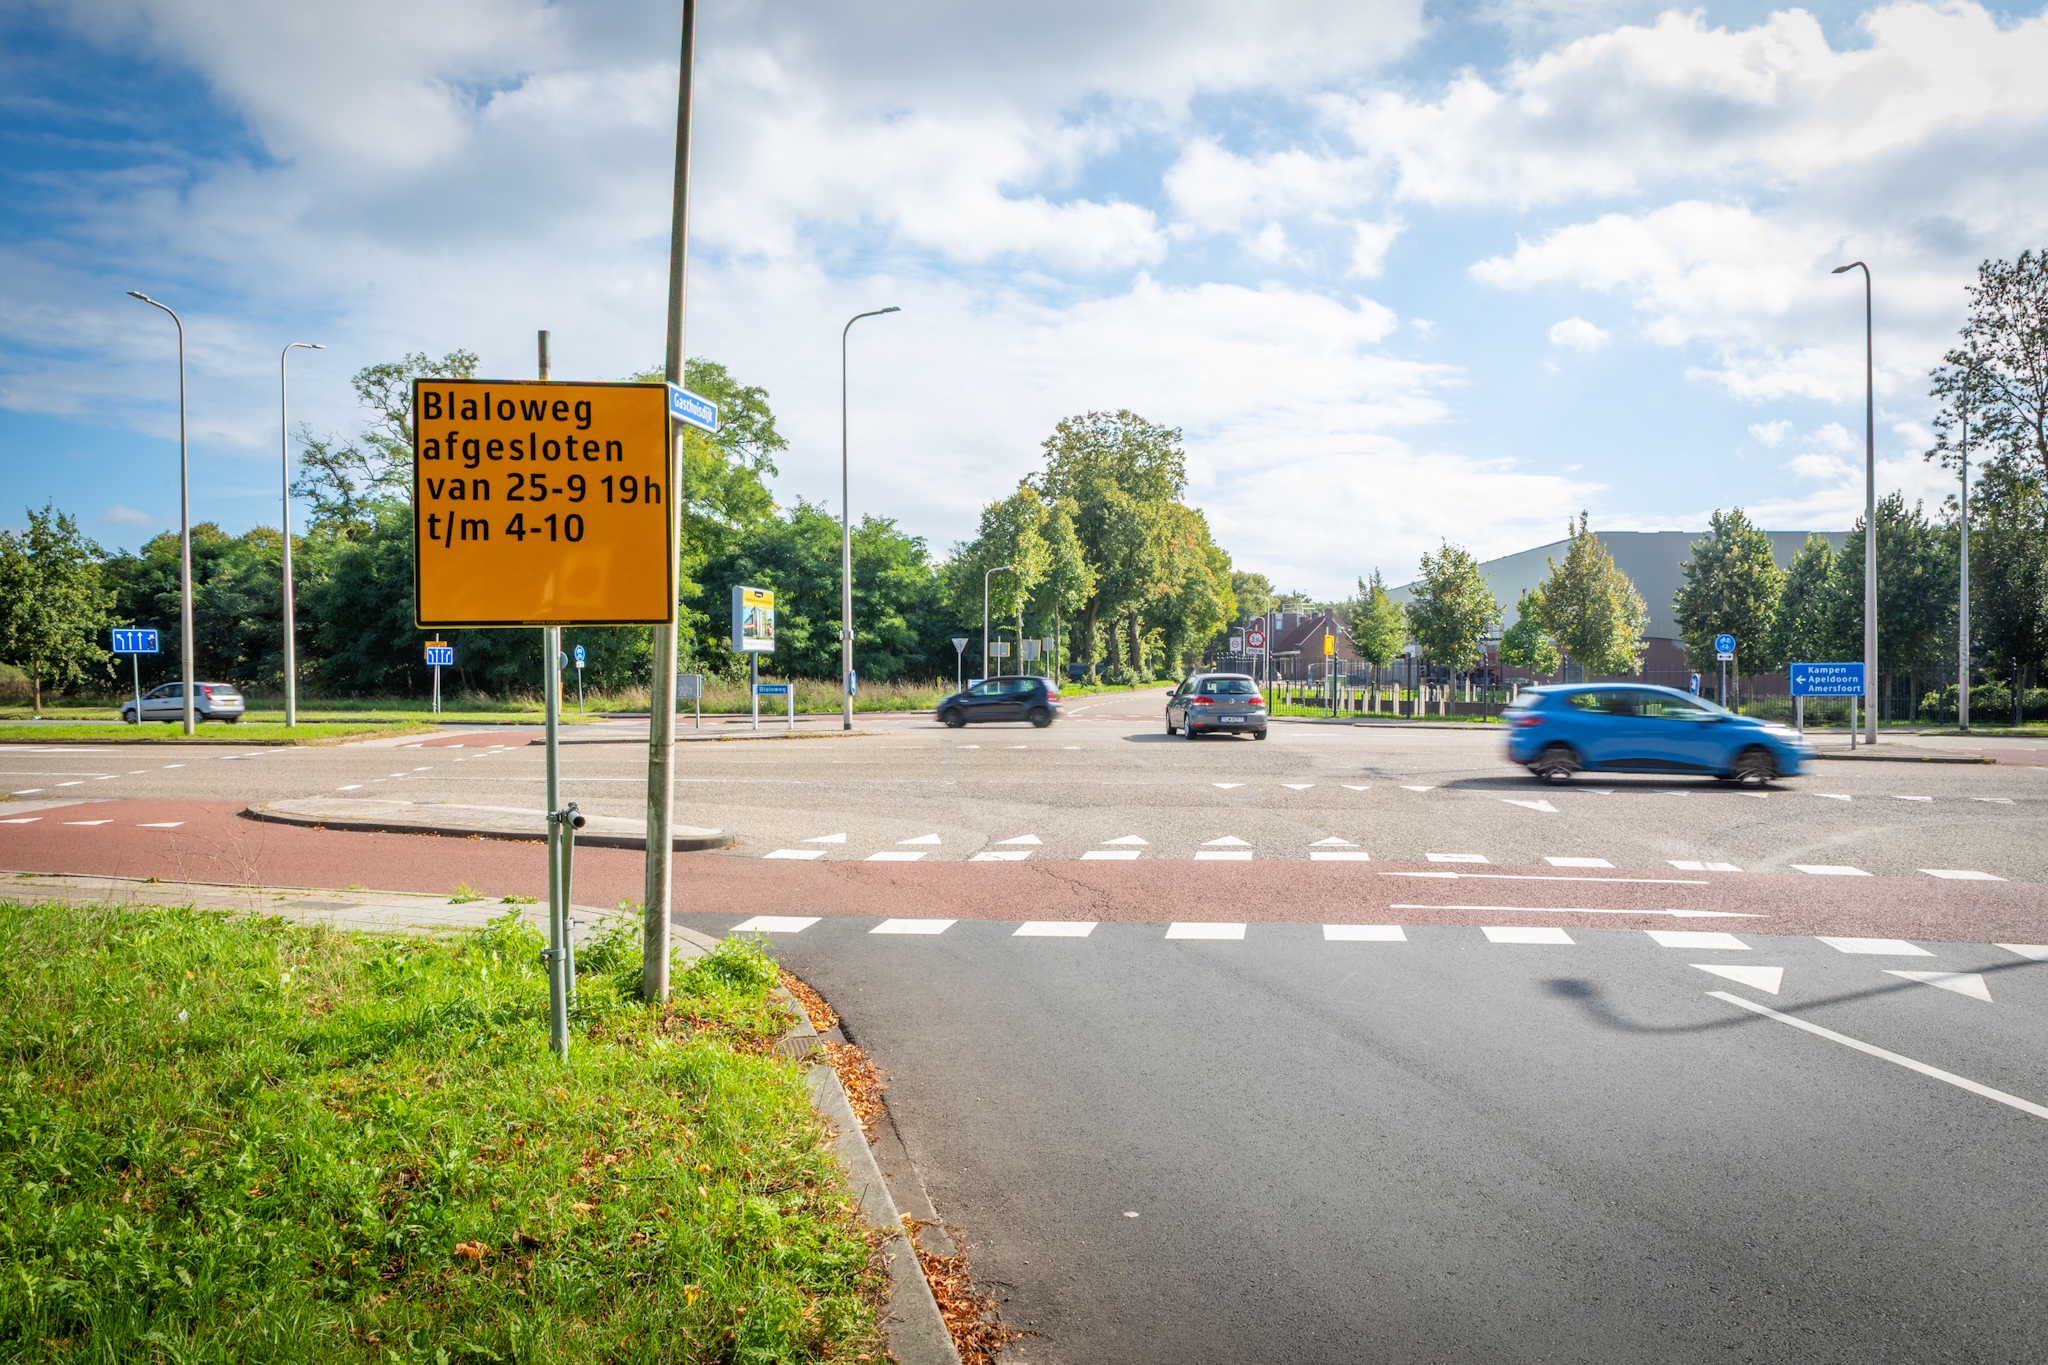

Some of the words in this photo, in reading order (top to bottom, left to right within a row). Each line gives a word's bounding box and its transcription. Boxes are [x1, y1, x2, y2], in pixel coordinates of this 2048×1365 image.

[423, 391, 592, 431] Blaloweg
[673, 392, 713, 424] Gasthuisdijk
[422, 430, 623, 469] afgesloten
[426, 477, 490, 501] van
[506, 472, 587, 503] 25-9
[600, 474, 661, 504] 19h
[427, 510, 489, 549] t/m
[505, 512, 584, 543] 4-10
[1808, 666, 1846, 675] Kampen
[1808, 675, 1858, 684] Apeldoorn
[1808, 684, 1861, 692] Amersfoort
